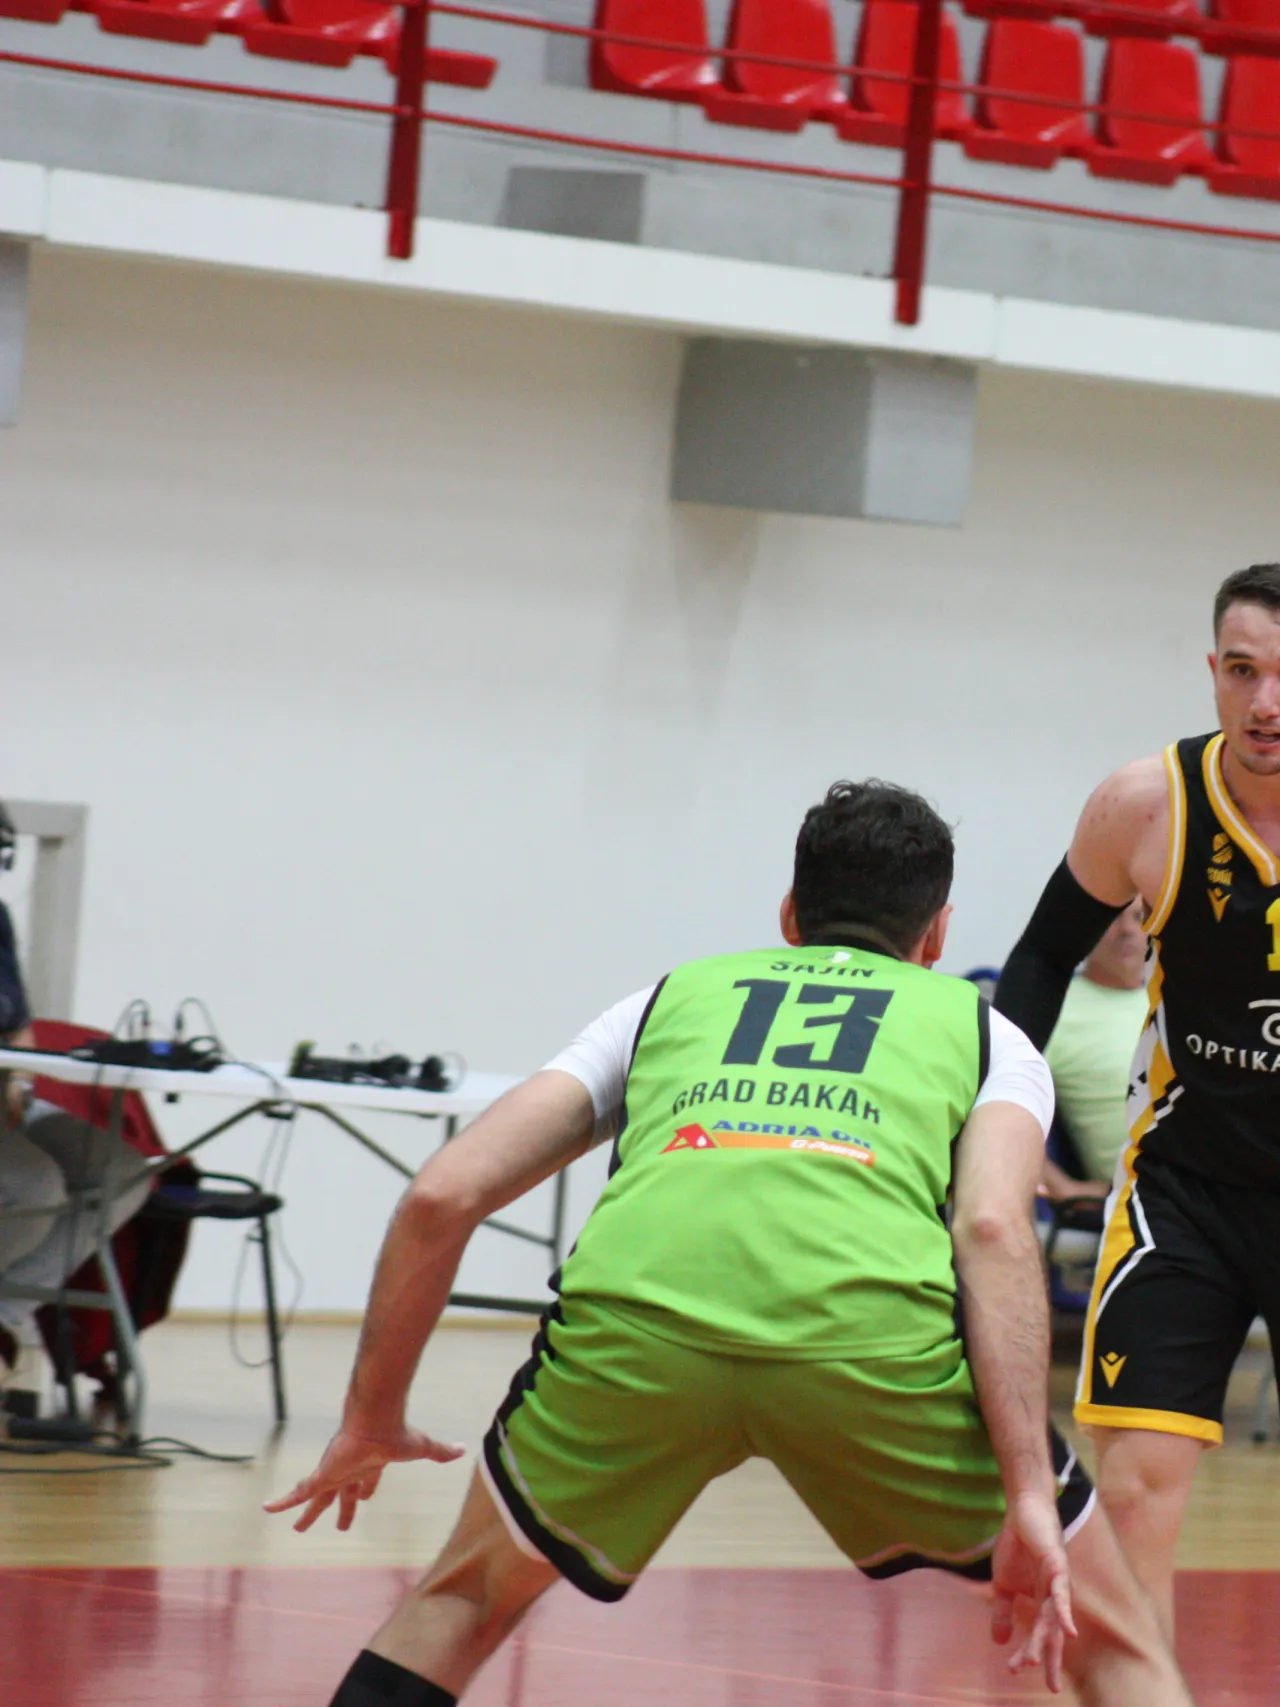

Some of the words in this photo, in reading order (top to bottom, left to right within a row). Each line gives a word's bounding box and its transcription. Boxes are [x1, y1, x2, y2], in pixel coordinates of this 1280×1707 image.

[720, 978, 895, 1074] 13
[672, 1078, 756, 1117] GRAD
[711, 1120, 822, 1138] ADRIA
